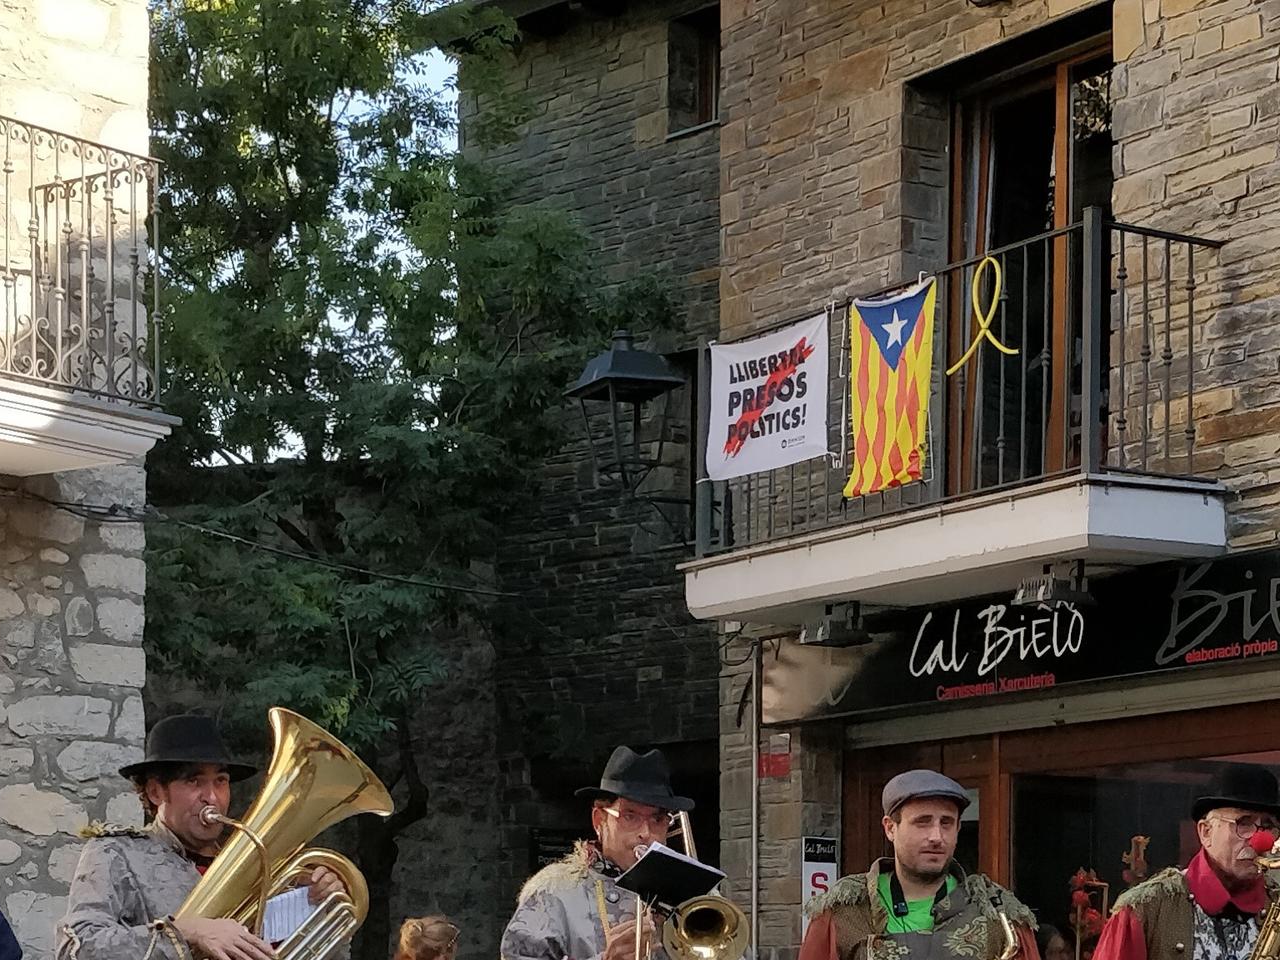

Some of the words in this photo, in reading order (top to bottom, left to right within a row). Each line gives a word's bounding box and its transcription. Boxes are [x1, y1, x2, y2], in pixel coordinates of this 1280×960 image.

[728, 371, 807, 417] PRESOS
[909, 609, 969, 677] Cal
[1185, 644, 1241, 664] elaboració
[1243, 639, 1278, 658] pròpia
